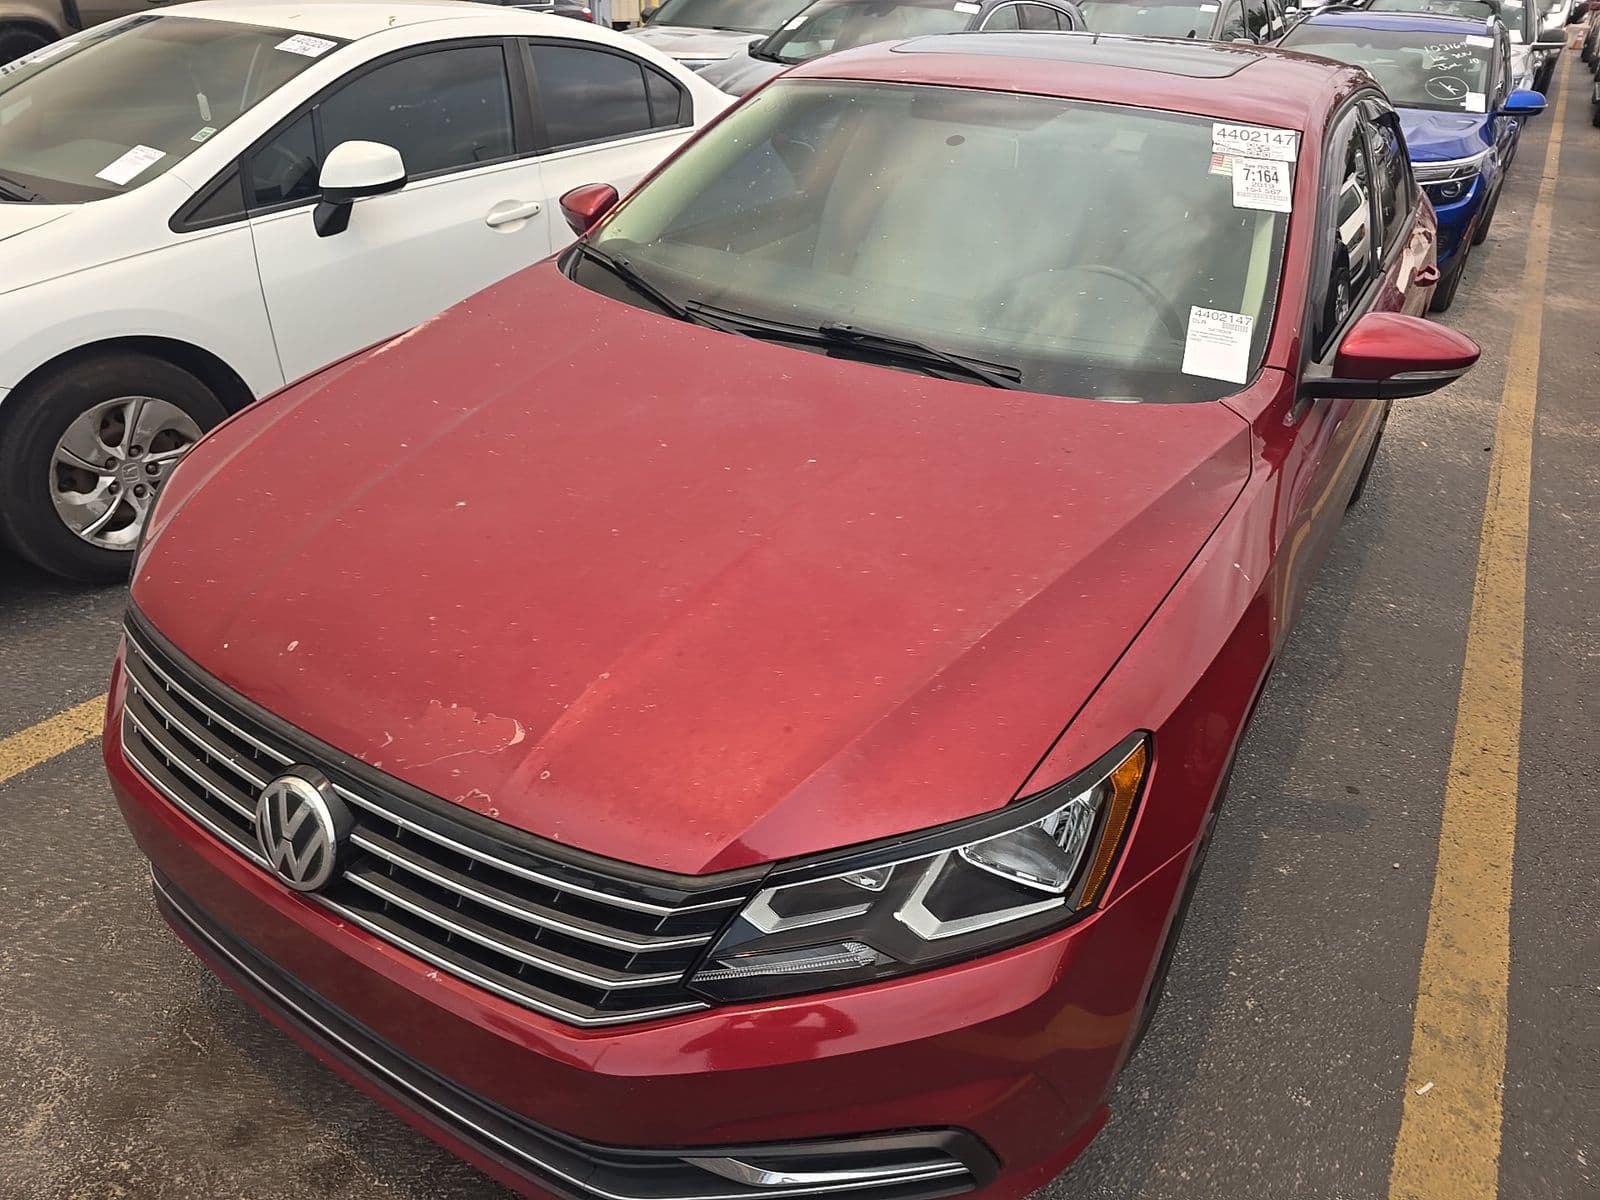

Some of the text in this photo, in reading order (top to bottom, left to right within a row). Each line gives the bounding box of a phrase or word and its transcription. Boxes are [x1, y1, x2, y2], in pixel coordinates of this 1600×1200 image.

[1217, 128, 1295, 145] 4402147
[1243, 168, 1279, 184] 7:164
[1195, 309, 1252, 325] 4402147
[258, 779, 334, 889] VW
